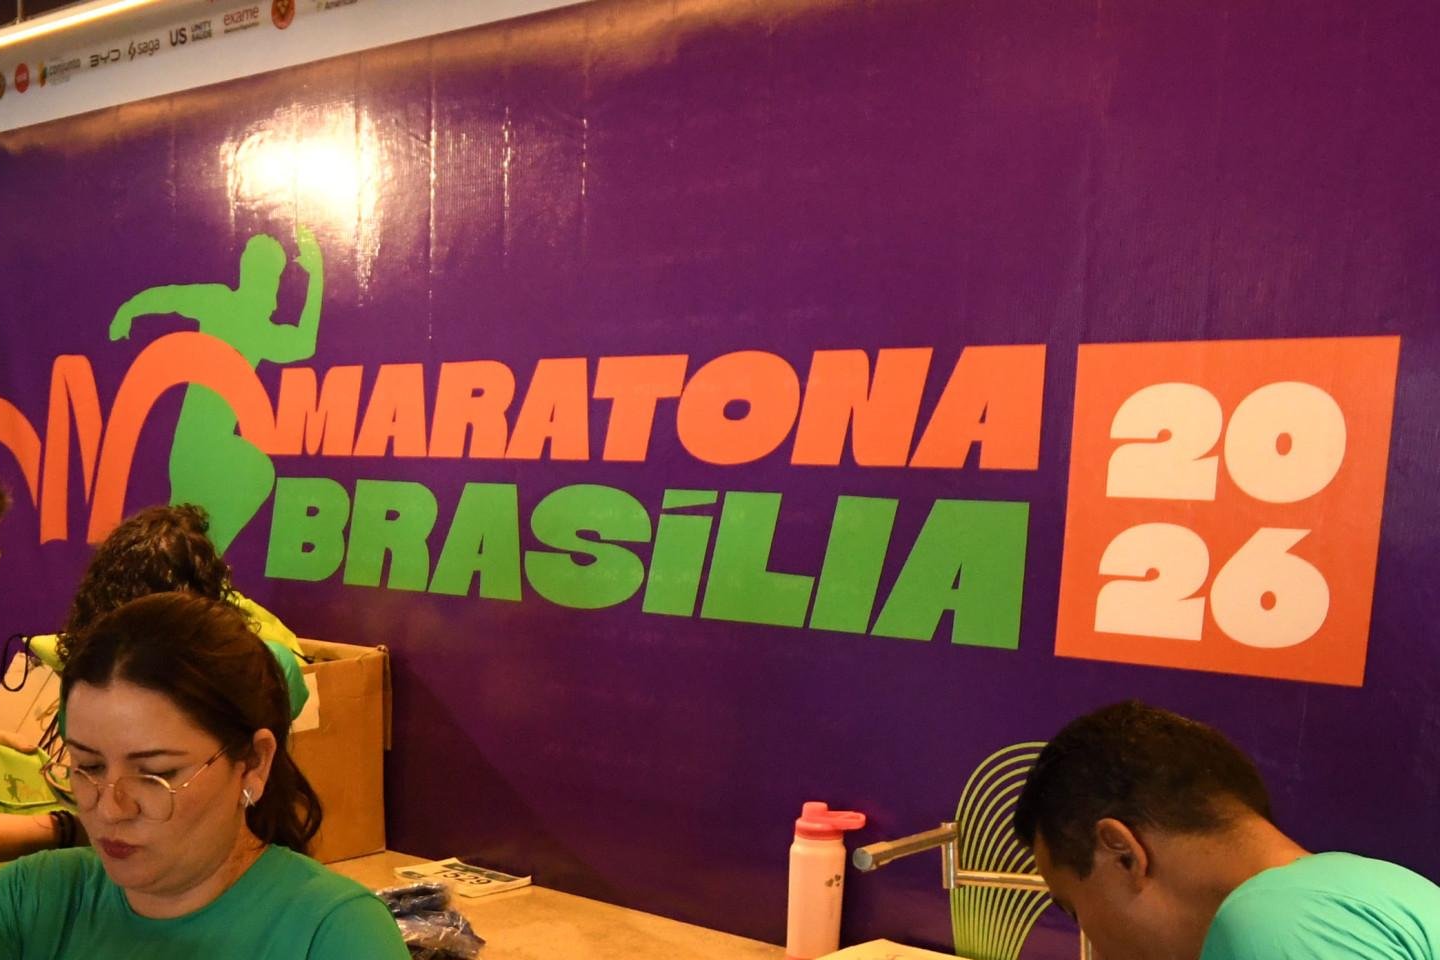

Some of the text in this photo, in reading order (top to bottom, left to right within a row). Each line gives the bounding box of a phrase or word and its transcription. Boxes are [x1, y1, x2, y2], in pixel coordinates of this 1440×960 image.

[89, 48, 121, 68] BYD
[137, 37, 160, 56] saga
[170, 27, 187, 47] US
[272, 344, 1046, 470] MARATONA
[1108, 381, 1346, 504] 20
[267, 477, 1028, 649] BRASÍLIA
[1093, 523, 1332, 650] 26
